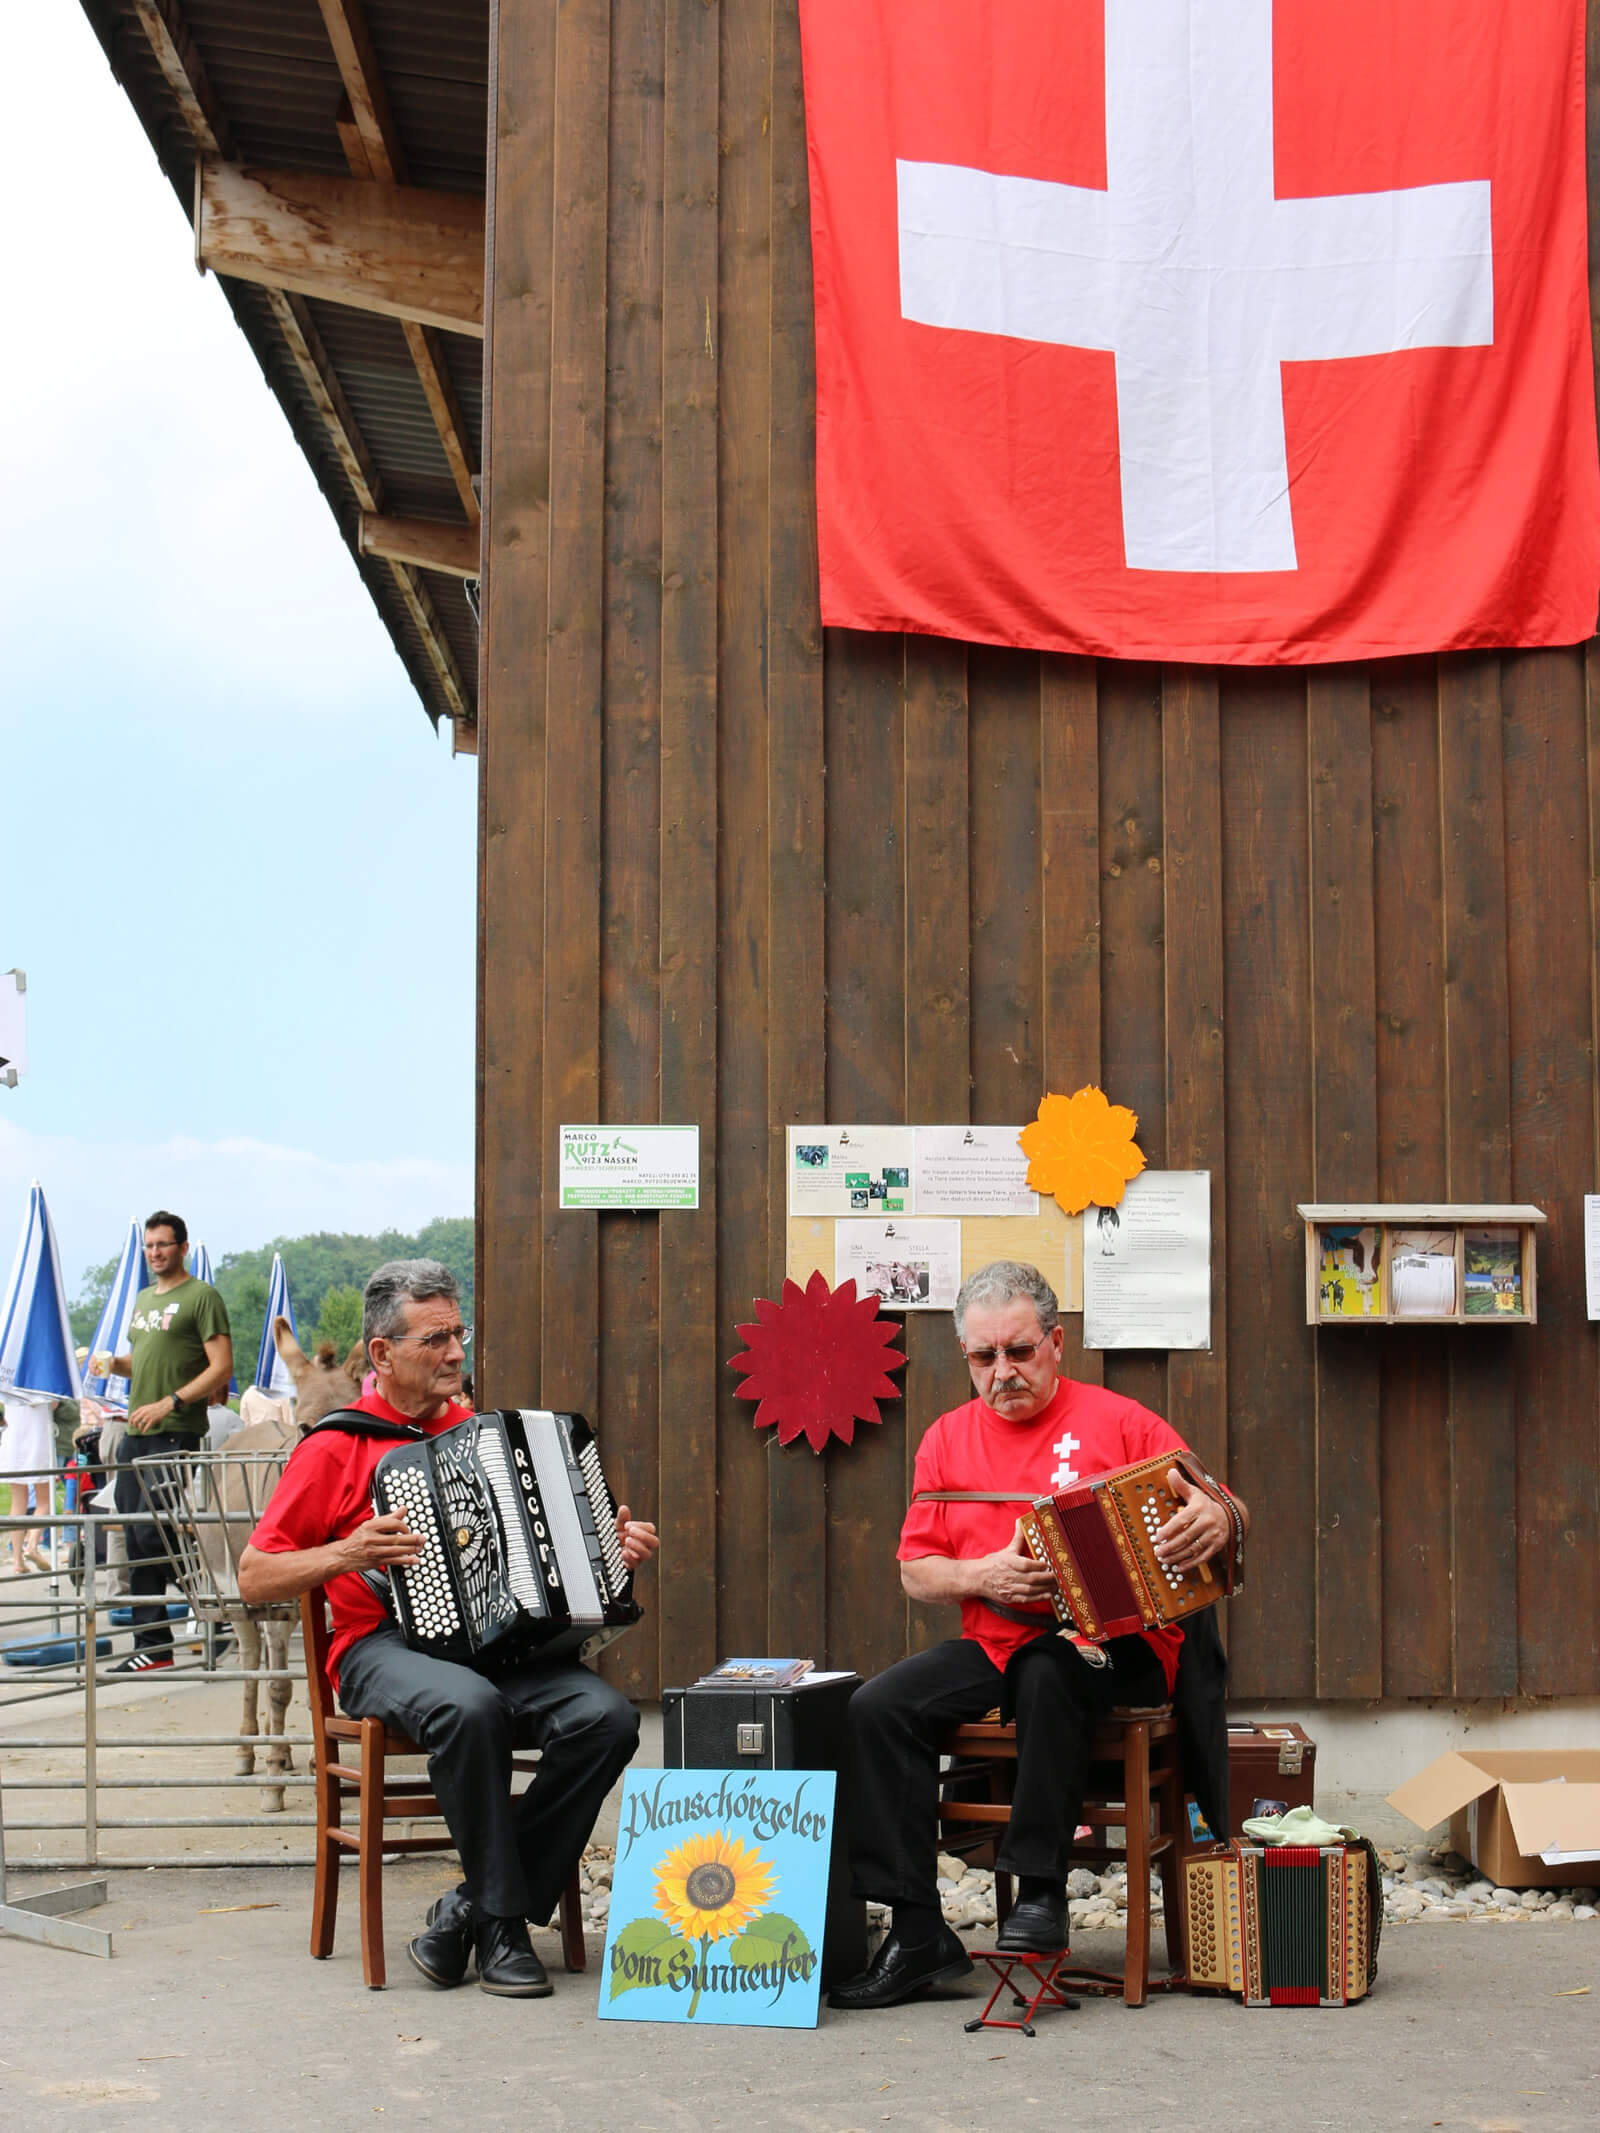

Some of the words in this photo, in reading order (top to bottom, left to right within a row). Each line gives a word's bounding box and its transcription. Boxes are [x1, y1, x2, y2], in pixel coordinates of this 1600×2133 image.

[564, 1133, 597, 1141] MARCO
[564, 1142, 611, 1166] RUTZ
[581, 1156, 602, 1165] 9123
[604, 1156, 638, 1165] NASSEN
[514, 1448, 560, 1588] Record
[666, 1931, 818, 2009] Sunneufer
